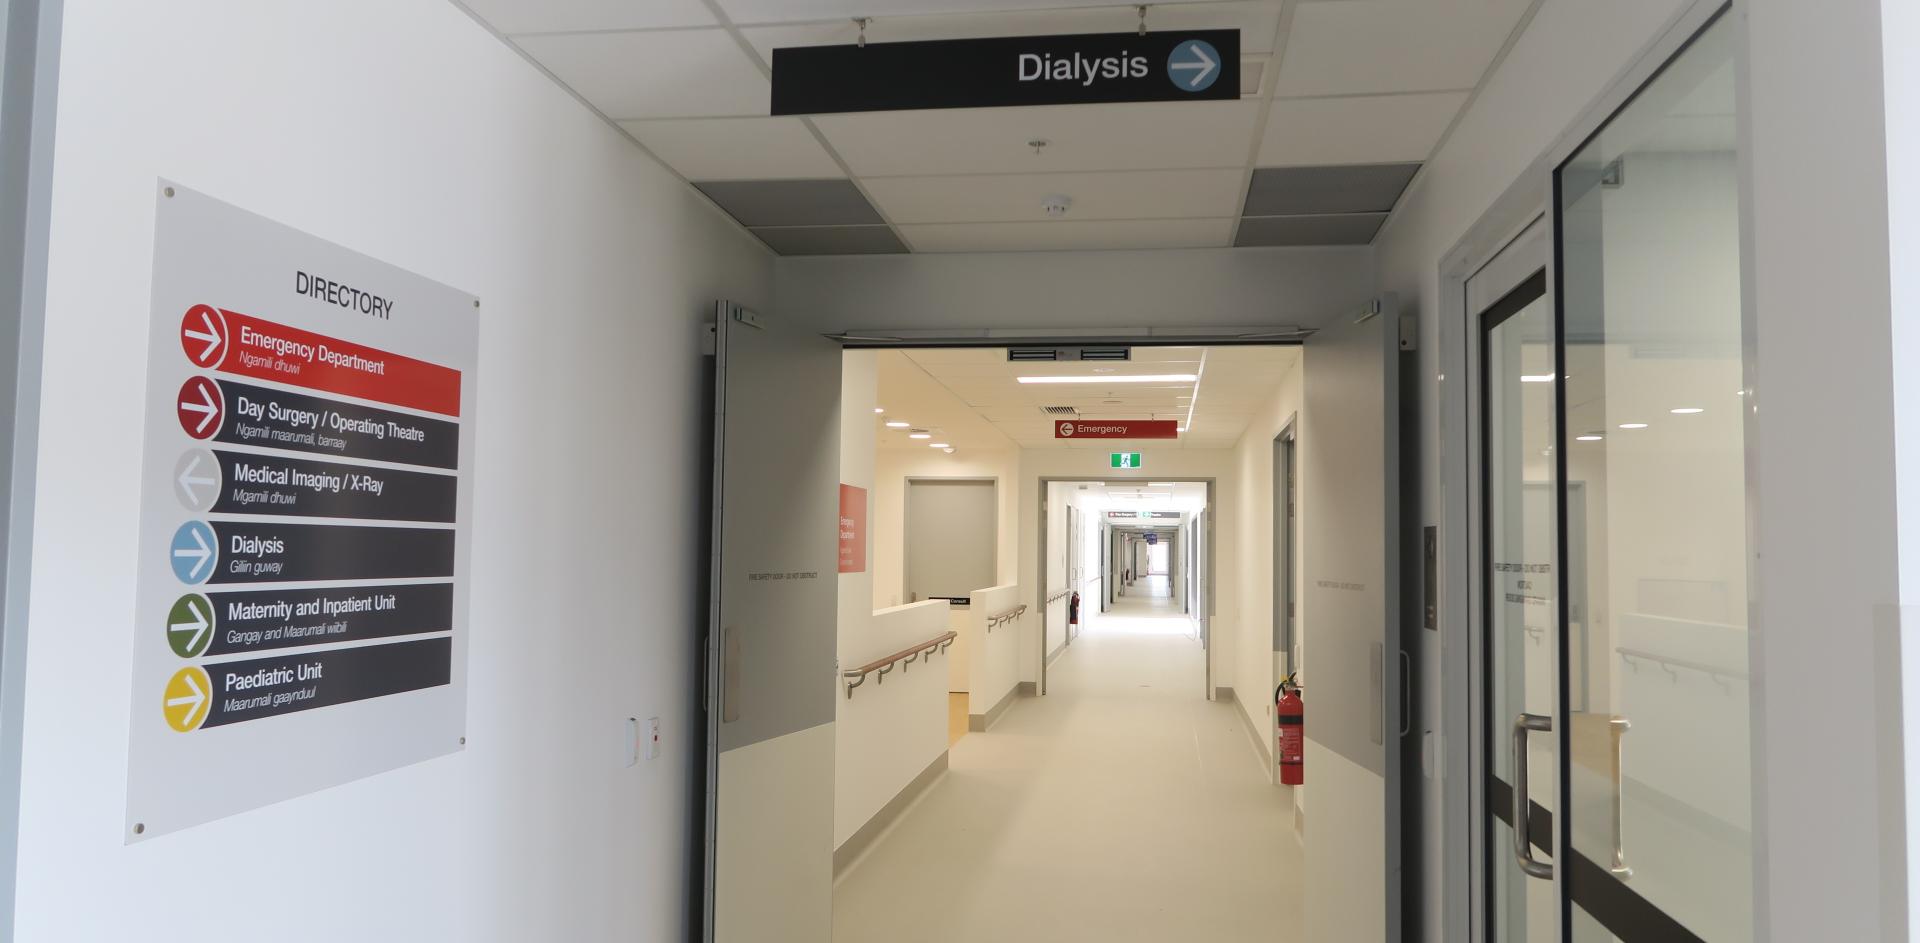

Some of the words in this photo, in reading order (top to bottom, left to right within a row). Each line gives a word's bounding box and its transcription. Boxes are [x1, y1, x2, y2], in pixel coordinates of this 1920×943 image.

[1018, 50, 1148, 86] Dialysis
[296, 270, 393, 320] DIRECTORY
[239, 351, 273, 369] Ngamili
[275, 358, 301, 375] dhuwi
[241, 325, 315, 362] Emergency
[318, 344, 385, 375] Department
[237, 396, 265, 421] Day
[268, 402, 319, 430] Surgery
[320, 410, 328, 427] /
[330, 412, 385, 439] Operating
[387, 421, 425, 442] Theatre
[1078, 424, 1128, 434] Emergency
[235, 422, 270, 439] Ngamili
[271, 430, 316, 446] maarumali,
[318, 434, 348, 451] barraay
[234, 462, 288, 485] Medical
[292, 468, 340, 493] Imaging
[342, 473, 349, 490] /
[350, 474, 384, 496] X-Ray
[270, 491, 297, 505] dhuwi
[231, 535, 284, 558] Dialysis
[253, 561, 284, 576] guway
[228, 600, 293, 621] Maternity
[296, 598, 320, 616] and
[323, 594, 372, 617] Inpatient
[374, 594, 396, 611] Unit
[227, 629, 263, 645] Gangay
[264, 626, 282, 641] and
[283, 623, 326, 638] Maarumali
[225, 666, 294, 692] Paediatric
[297, 662, 323, 681] Unit
[223, 692, 273, 712] Maarumali
